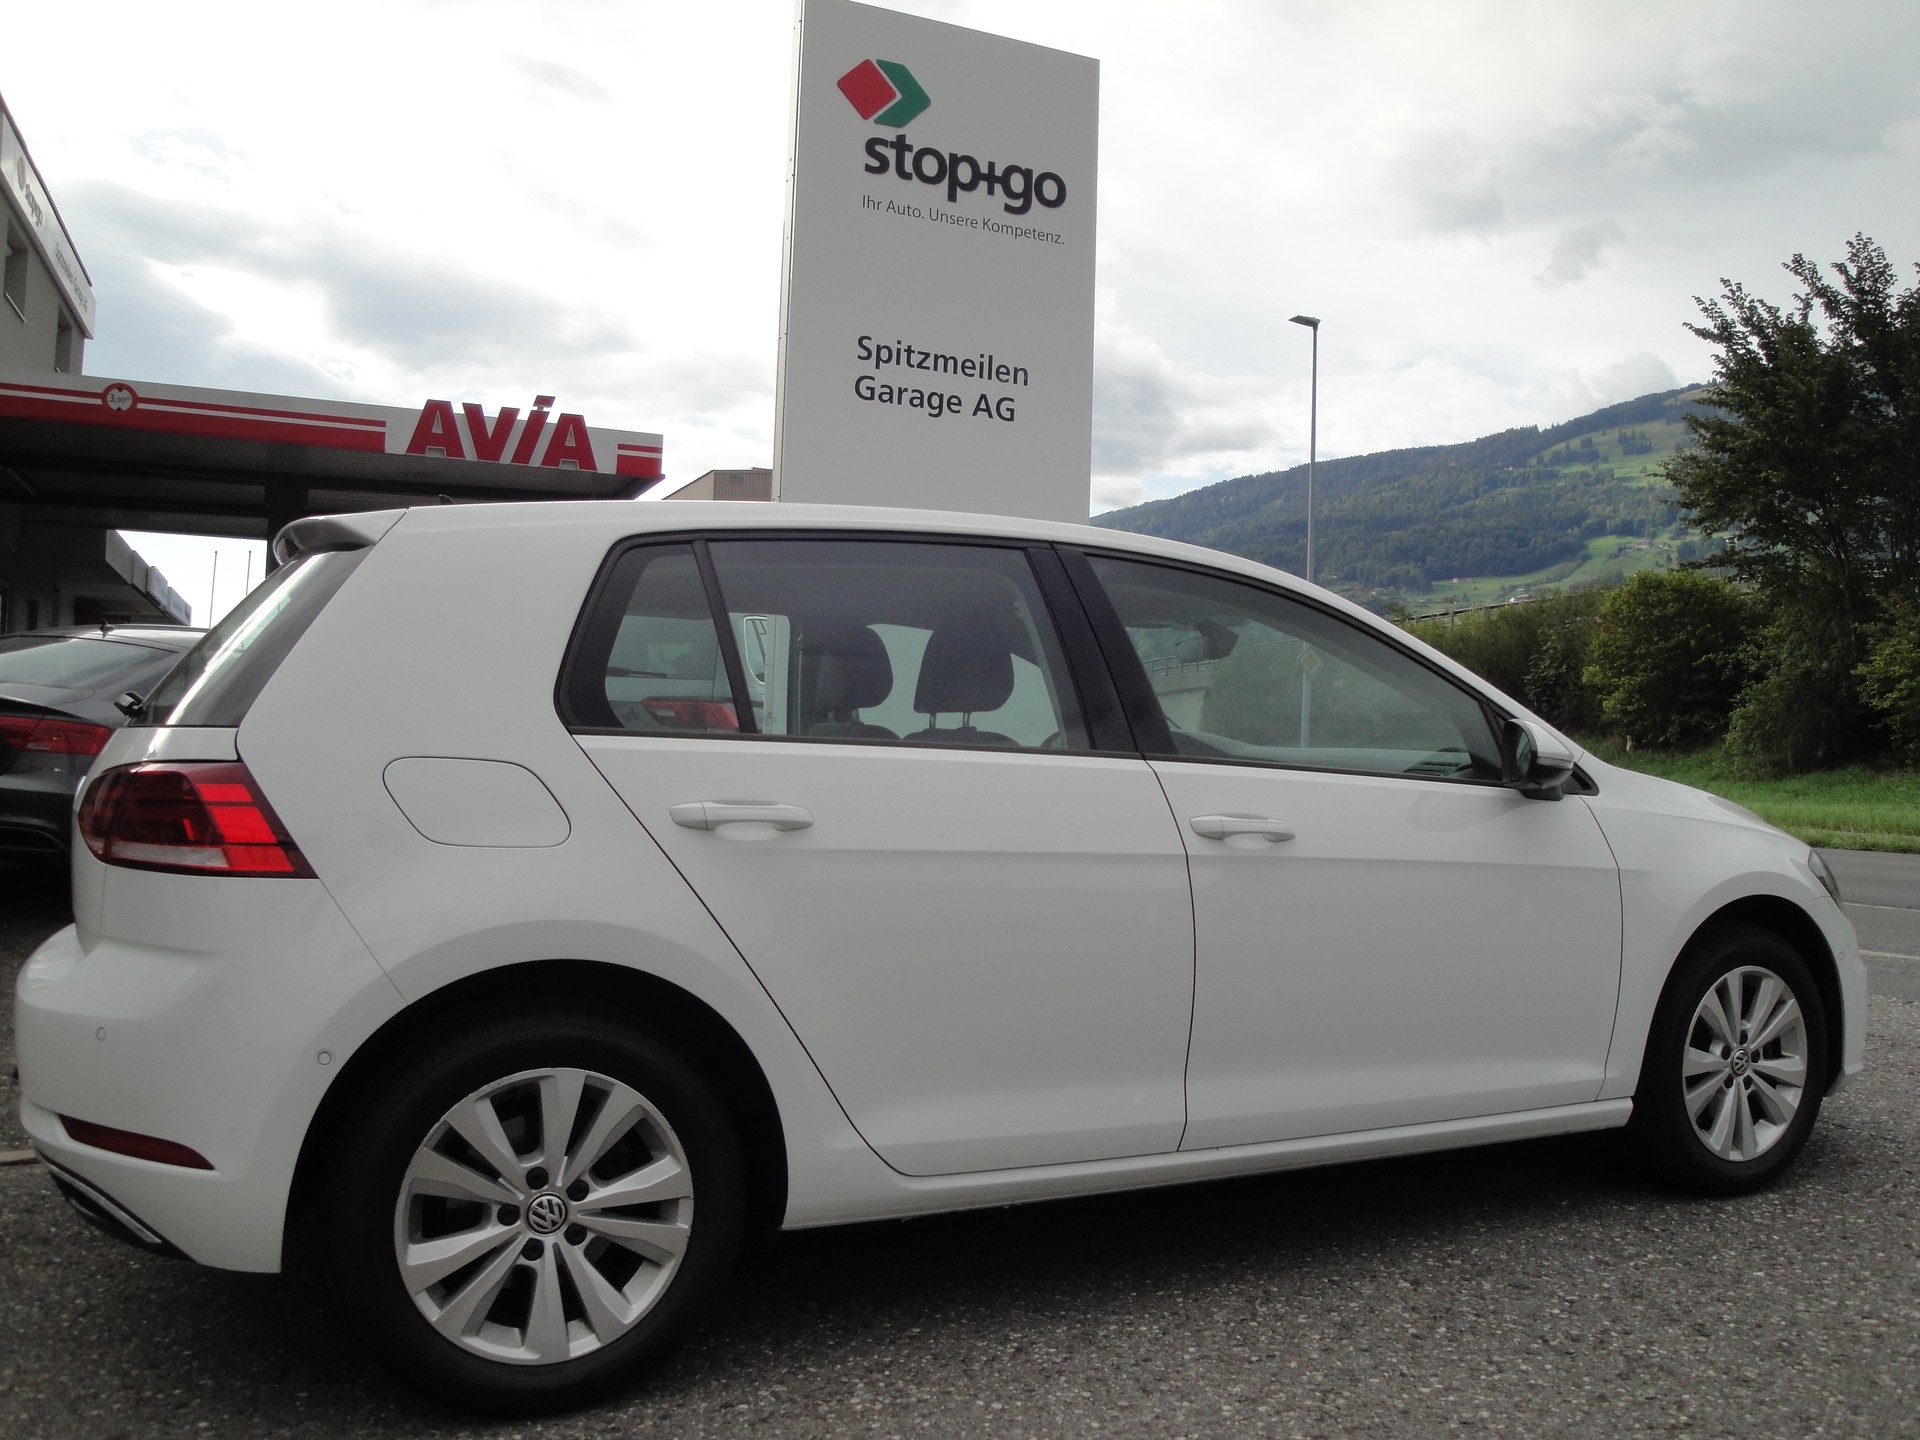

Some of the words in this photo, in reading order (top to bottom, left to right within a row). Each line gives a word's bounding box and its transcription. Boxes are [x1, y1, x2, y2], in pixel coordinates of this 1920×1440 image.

[864, 134, 1067, 215] stop+go
[862, 195, 882, 211] Ihr
[886, 200, 924, 219] Auto.
[929, 208, 978, 229] Unsere
[982, 218, 1065, 245] Kompetenz.
[857, 335, 1029, 386] Spitzmeilen
[855, 375, 962, 418] Garage
[972, 393, 1015, 422] AG
